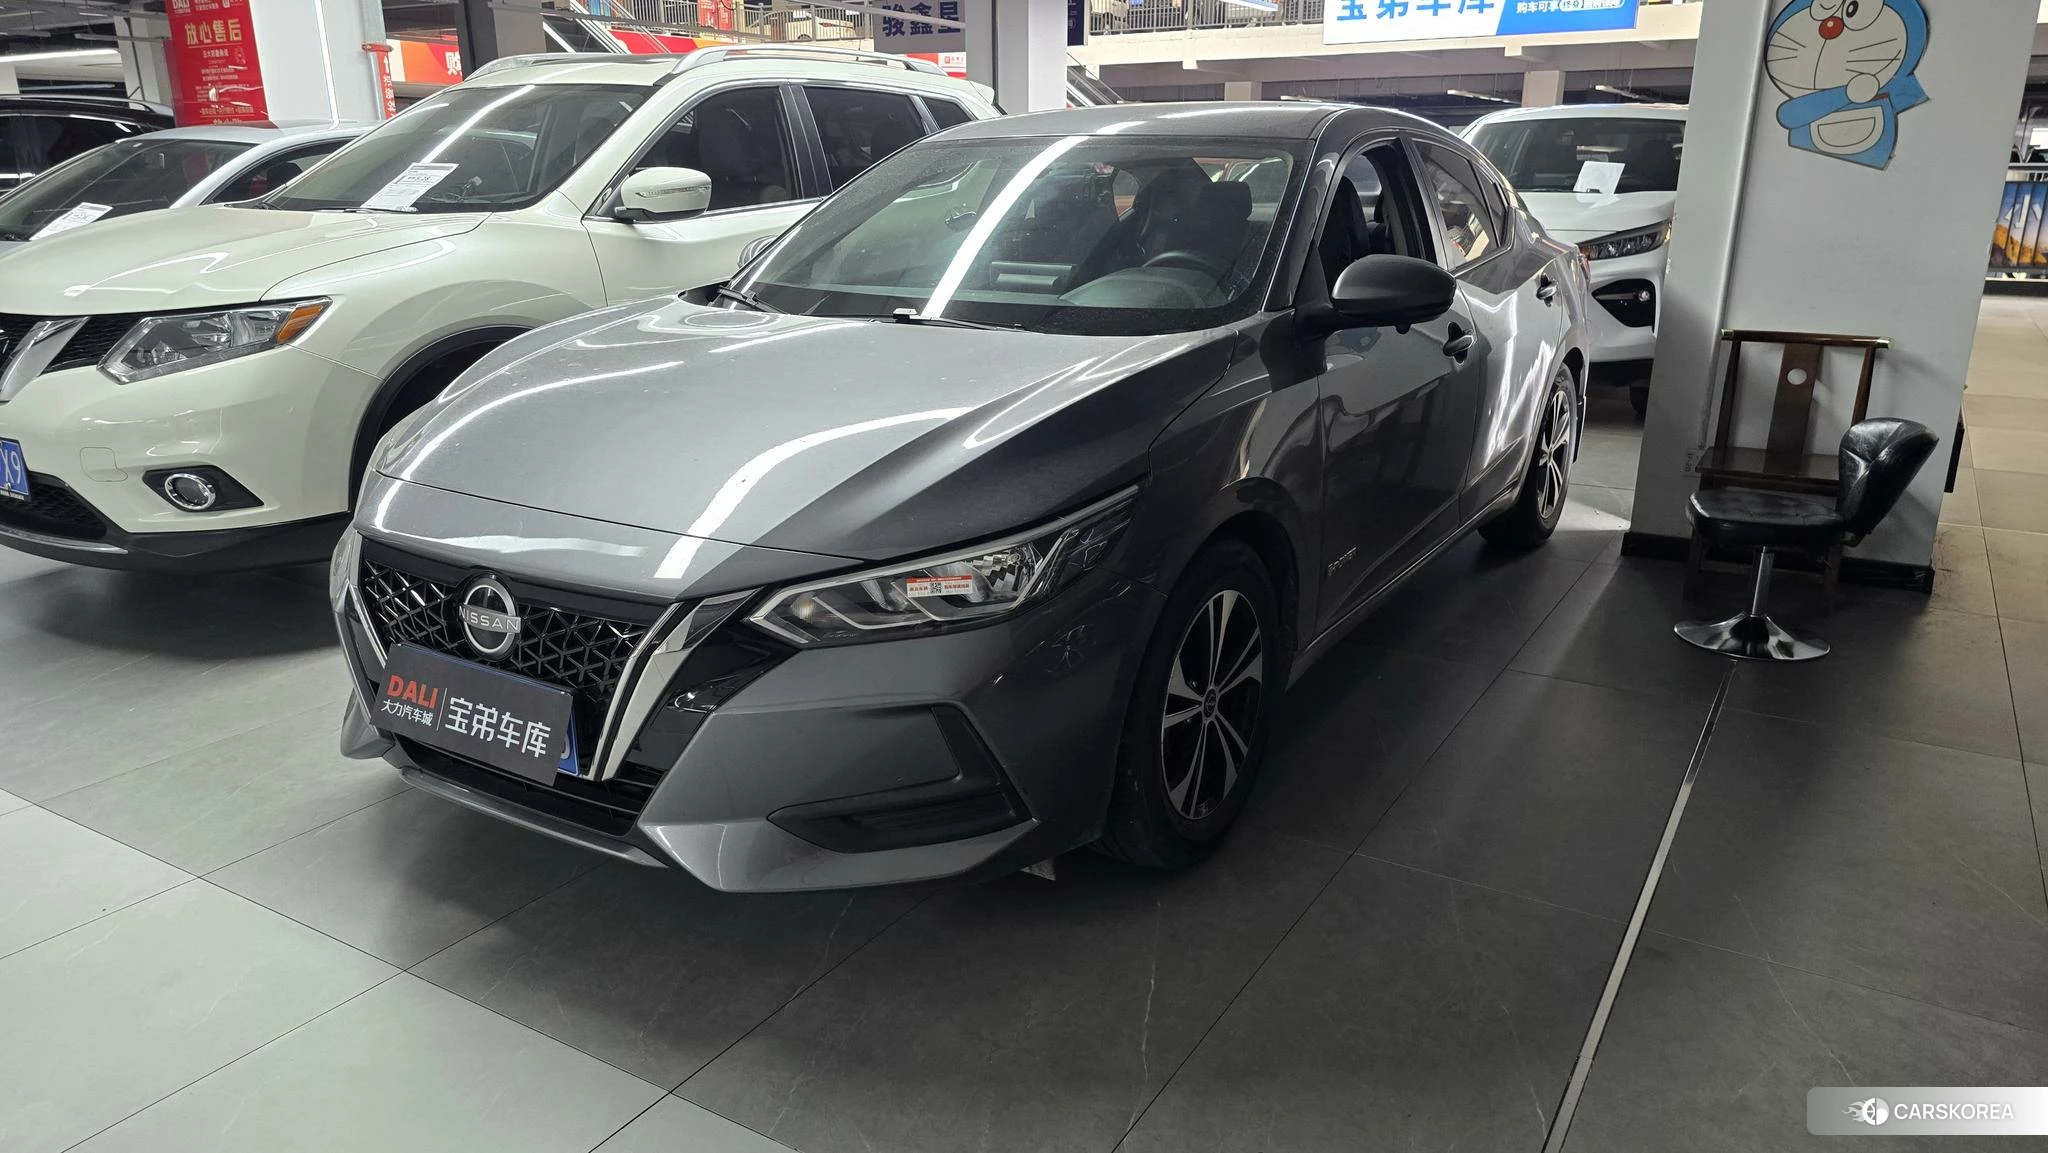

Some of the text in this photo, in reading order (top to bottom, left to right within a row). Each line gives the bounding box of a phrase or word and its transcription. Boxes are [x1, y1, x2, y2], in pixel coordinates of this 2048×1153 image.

[185, 19, 242, 45] 放心售后
[459, 605, 519, 631] NISSAN
[387, 675, 440, 709] DALI
[381, 699, 434, 727] 大力汽车城
[445, 696, 551, 758] 宝弟车库
